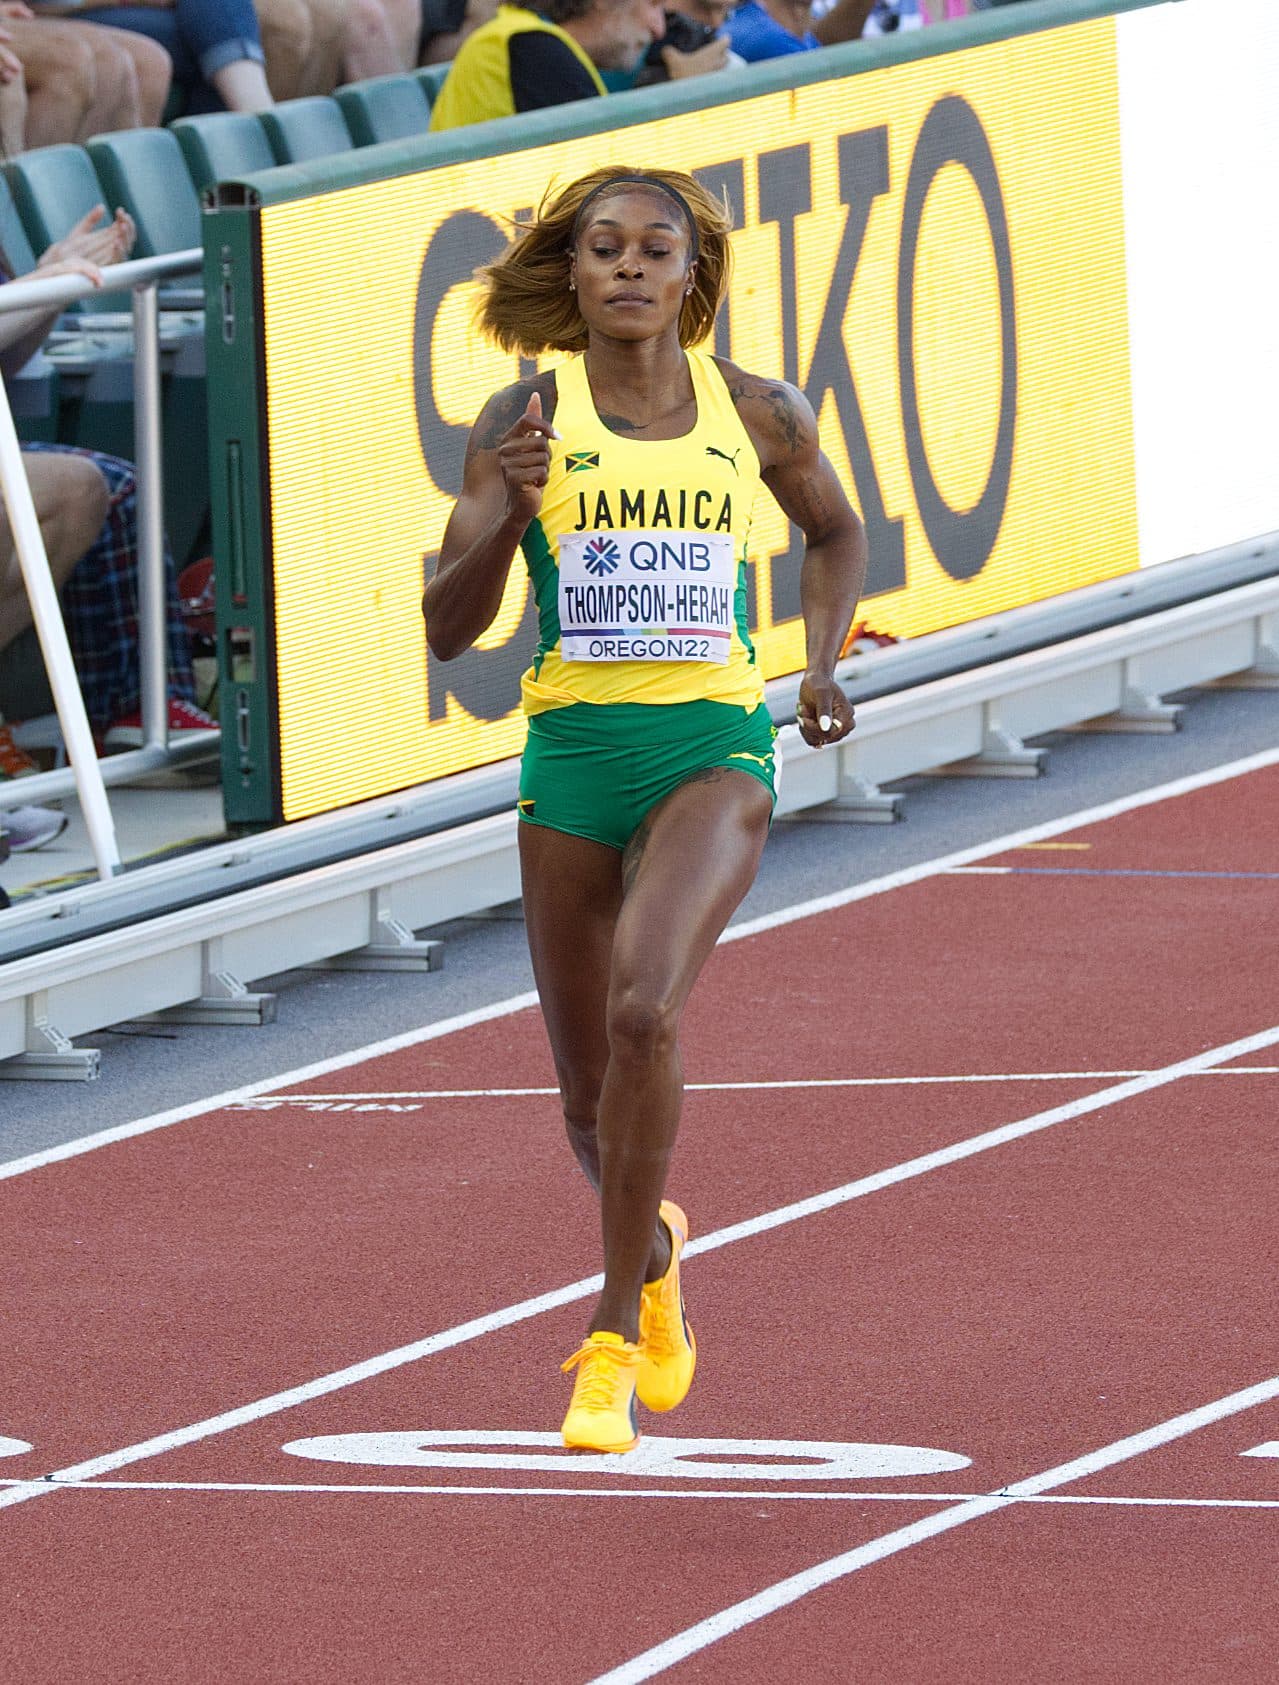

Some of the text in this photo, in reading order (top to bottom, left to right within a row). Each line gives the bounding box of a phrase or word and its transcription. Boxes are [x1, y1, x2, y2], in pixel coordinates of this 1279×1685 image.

[412, 97, 1017, 726] SKO
[574, 489, 732, 533] JAMAICA
[629, 541, 711, 572] QNB
[564, 584, 729, 626] THOMPSON-HERAH
[589, 640, 710, 658] OREGON22
